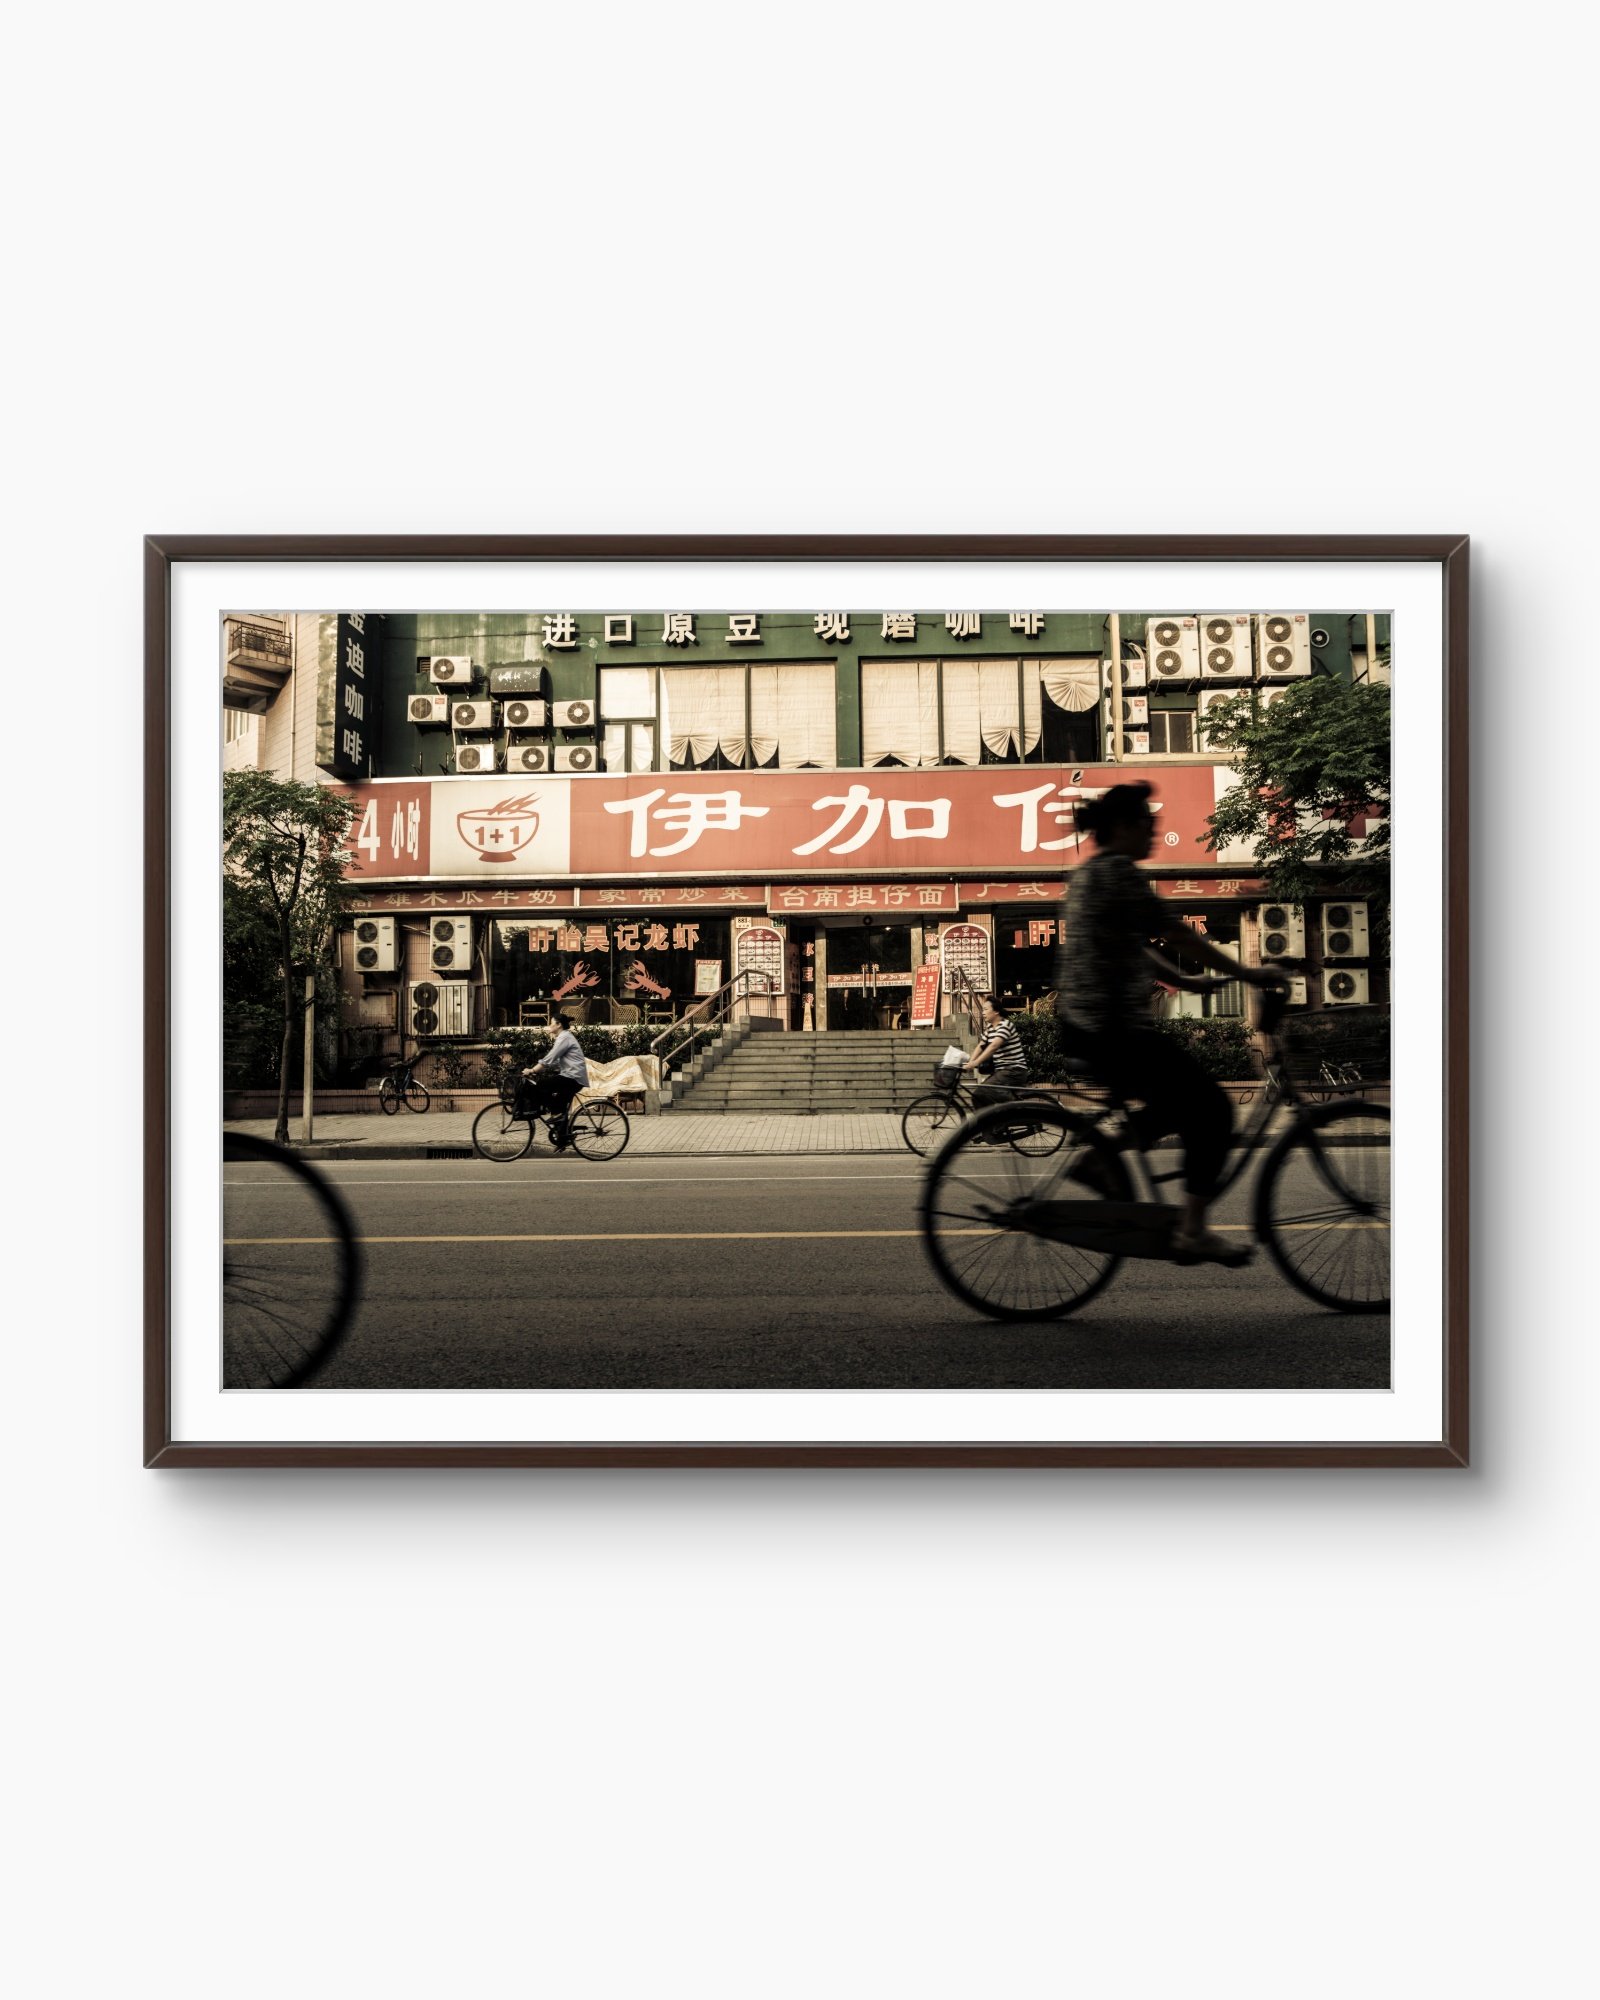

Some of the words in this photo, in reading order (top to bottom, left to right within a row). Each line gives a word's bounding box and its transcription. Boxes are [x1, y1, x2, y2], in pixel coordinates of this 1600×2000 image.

[474, 825, 520, 846] 1+1
[596, 886, 750, 903] 家常炒菜
[779, 884, 947, 907] 台南担仔面
[528, 922, 700, 953] 盱眙吴记龙虾
